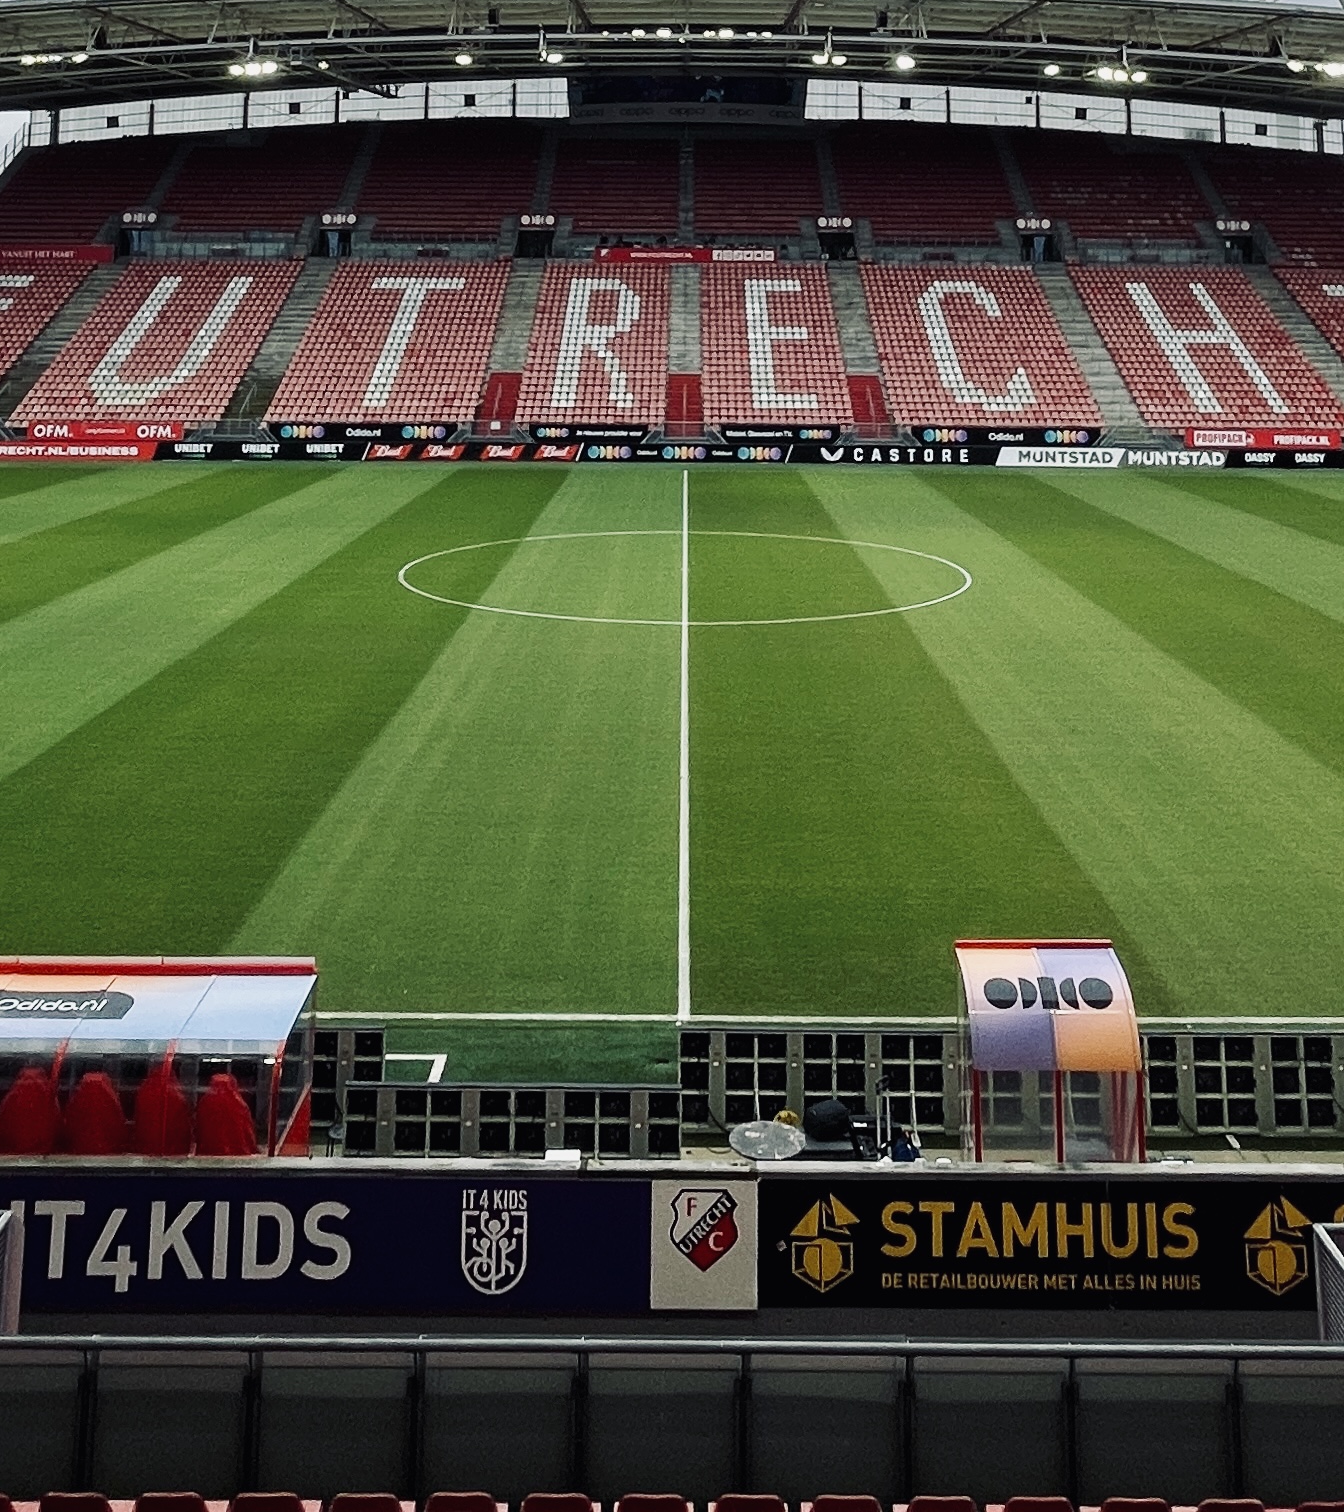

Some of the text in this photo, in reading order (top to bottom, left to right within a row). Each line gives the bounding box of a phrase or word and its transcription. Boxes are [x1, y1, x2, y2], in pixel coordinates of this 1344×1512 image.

[33, 424, 74, 438] OFM.
[136, 424, 176, 438] OFM.
[1196, 432, 1244, 444] PROFIPACK
[174, 443, 213, 453] UNIBET
[241, 443, 280, 454] UNIBET
[306, 443, 344, 454] UNIBET
[854, 447, 969, 463] CASTORE
[1018, 450, 1114, 464] MUNTSTAD
[1128, 450, 1226, 466] MUNTSTAD
[1244, 452, 1276, 463] DASSY
[1294, 452, 1326, 464] DASSY
[462, 1189, 528, 1210] IT 4 KIDS
[685, 1197, 698, 1217] F
[678, 1192, 735, 1257] UTRECHT
[880, 1201, 1199, 1259] STAMHUIS
[11, 1200, 352, 1293] T4KIDS
[881, 1273, 1201, 1291] DE RETAILBOUWER MET ALLES IN HUIS
